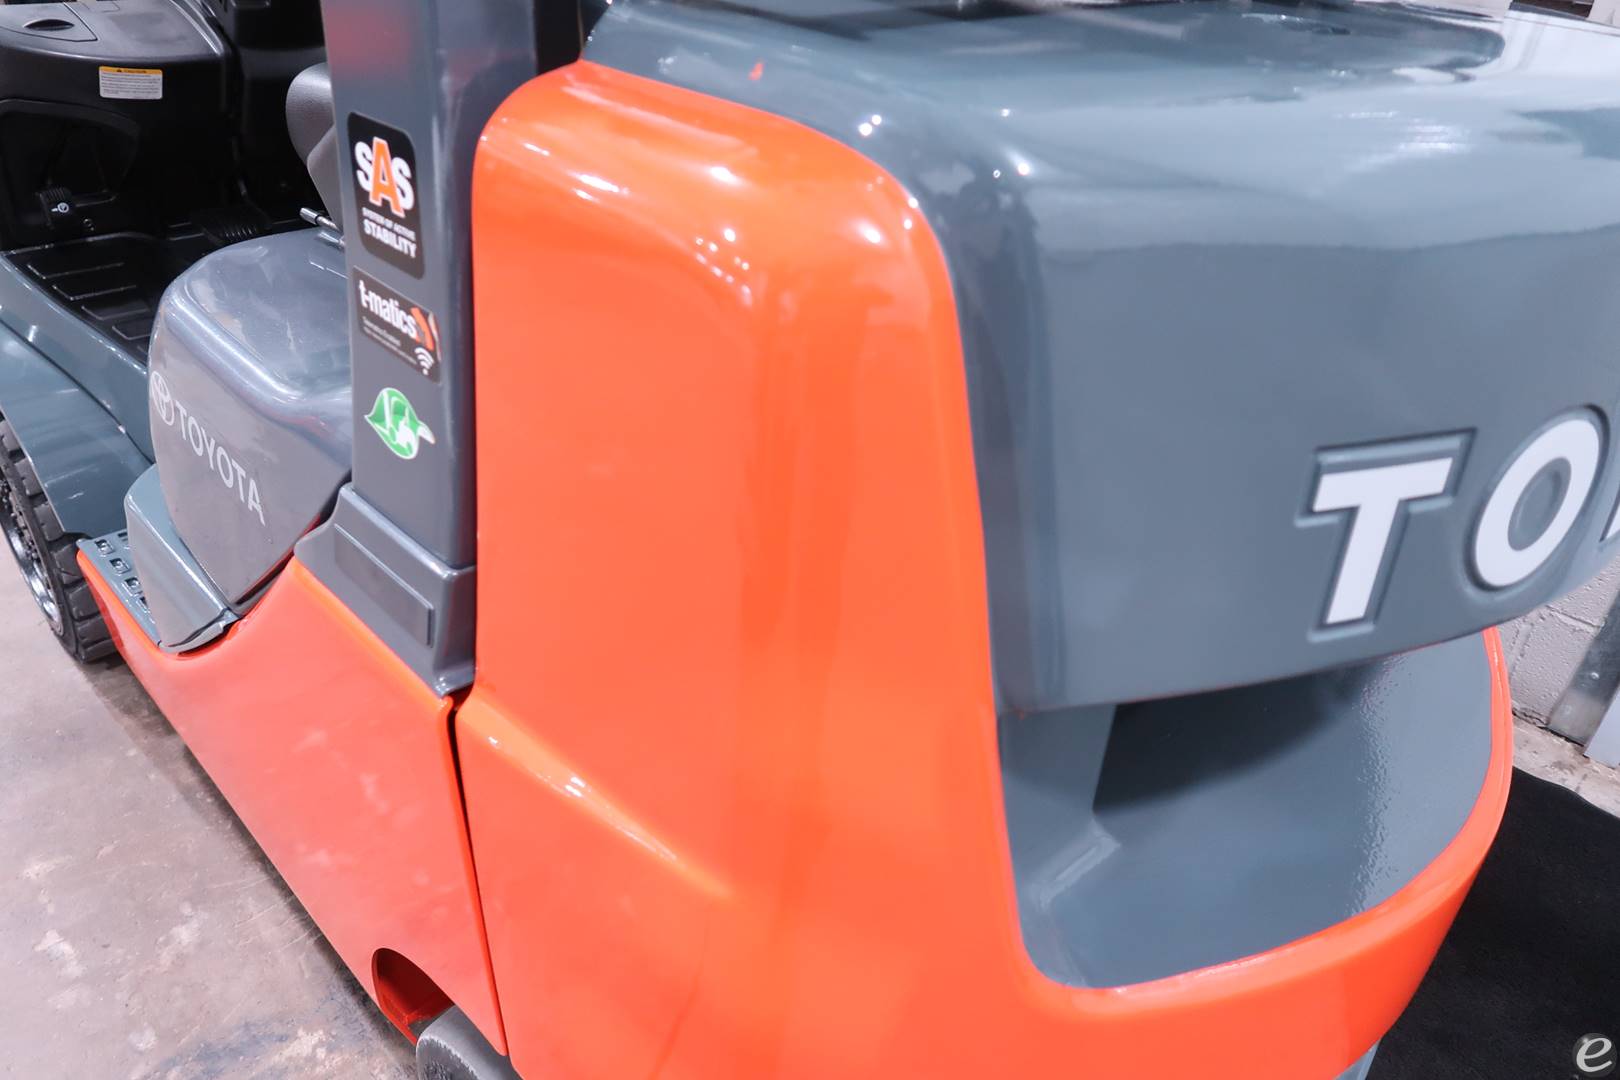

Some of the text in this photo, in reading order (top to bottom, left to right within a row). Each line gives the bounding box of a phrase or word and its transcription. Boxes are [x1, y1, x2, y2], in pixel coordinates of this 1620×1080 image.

[355, 136, 414, 218] SAS
[363, 218, 417, 258] STABILITY
[358, 280, 417, 339] t-matics
[174, 400, 265, 526] TOYOTA
[1312, 418, 1620, 625] TO
